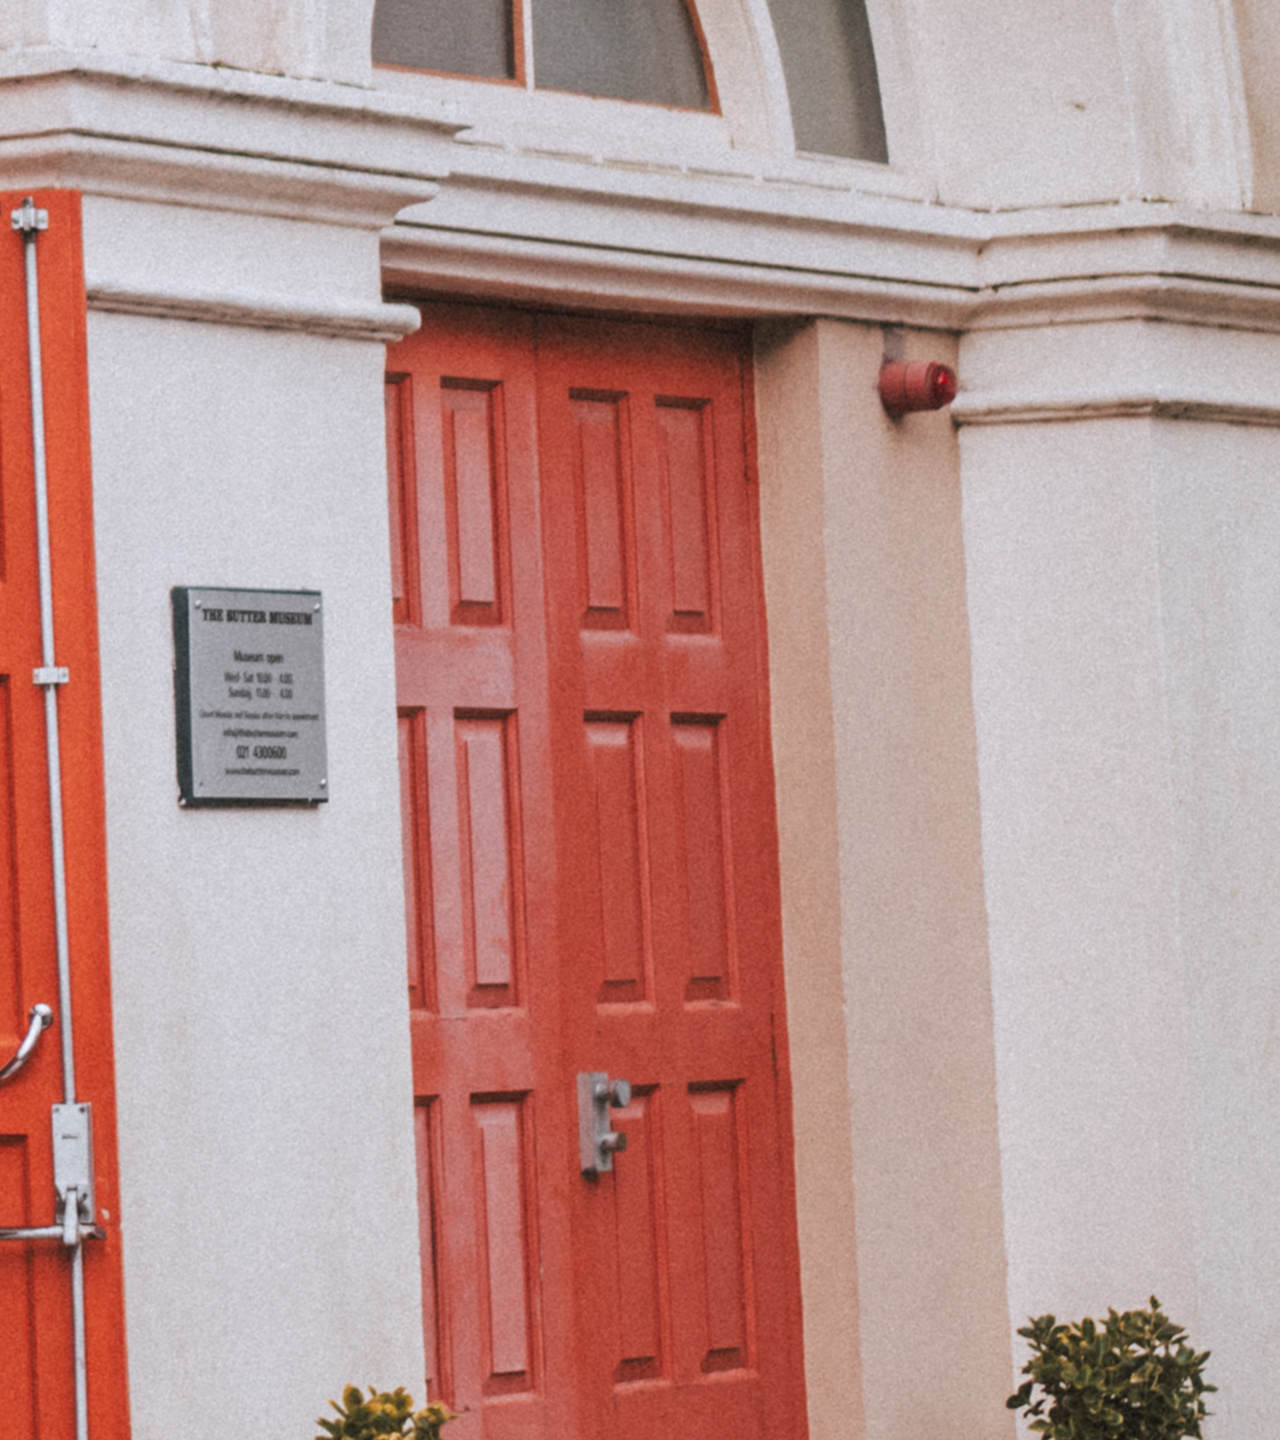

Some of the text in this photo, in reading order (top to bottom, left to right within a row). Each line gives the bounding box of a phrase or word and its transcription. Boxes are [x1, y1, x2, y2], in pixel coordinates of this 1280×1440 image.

[202, 608, 312, 625] THE BUTTER MUSEUM
